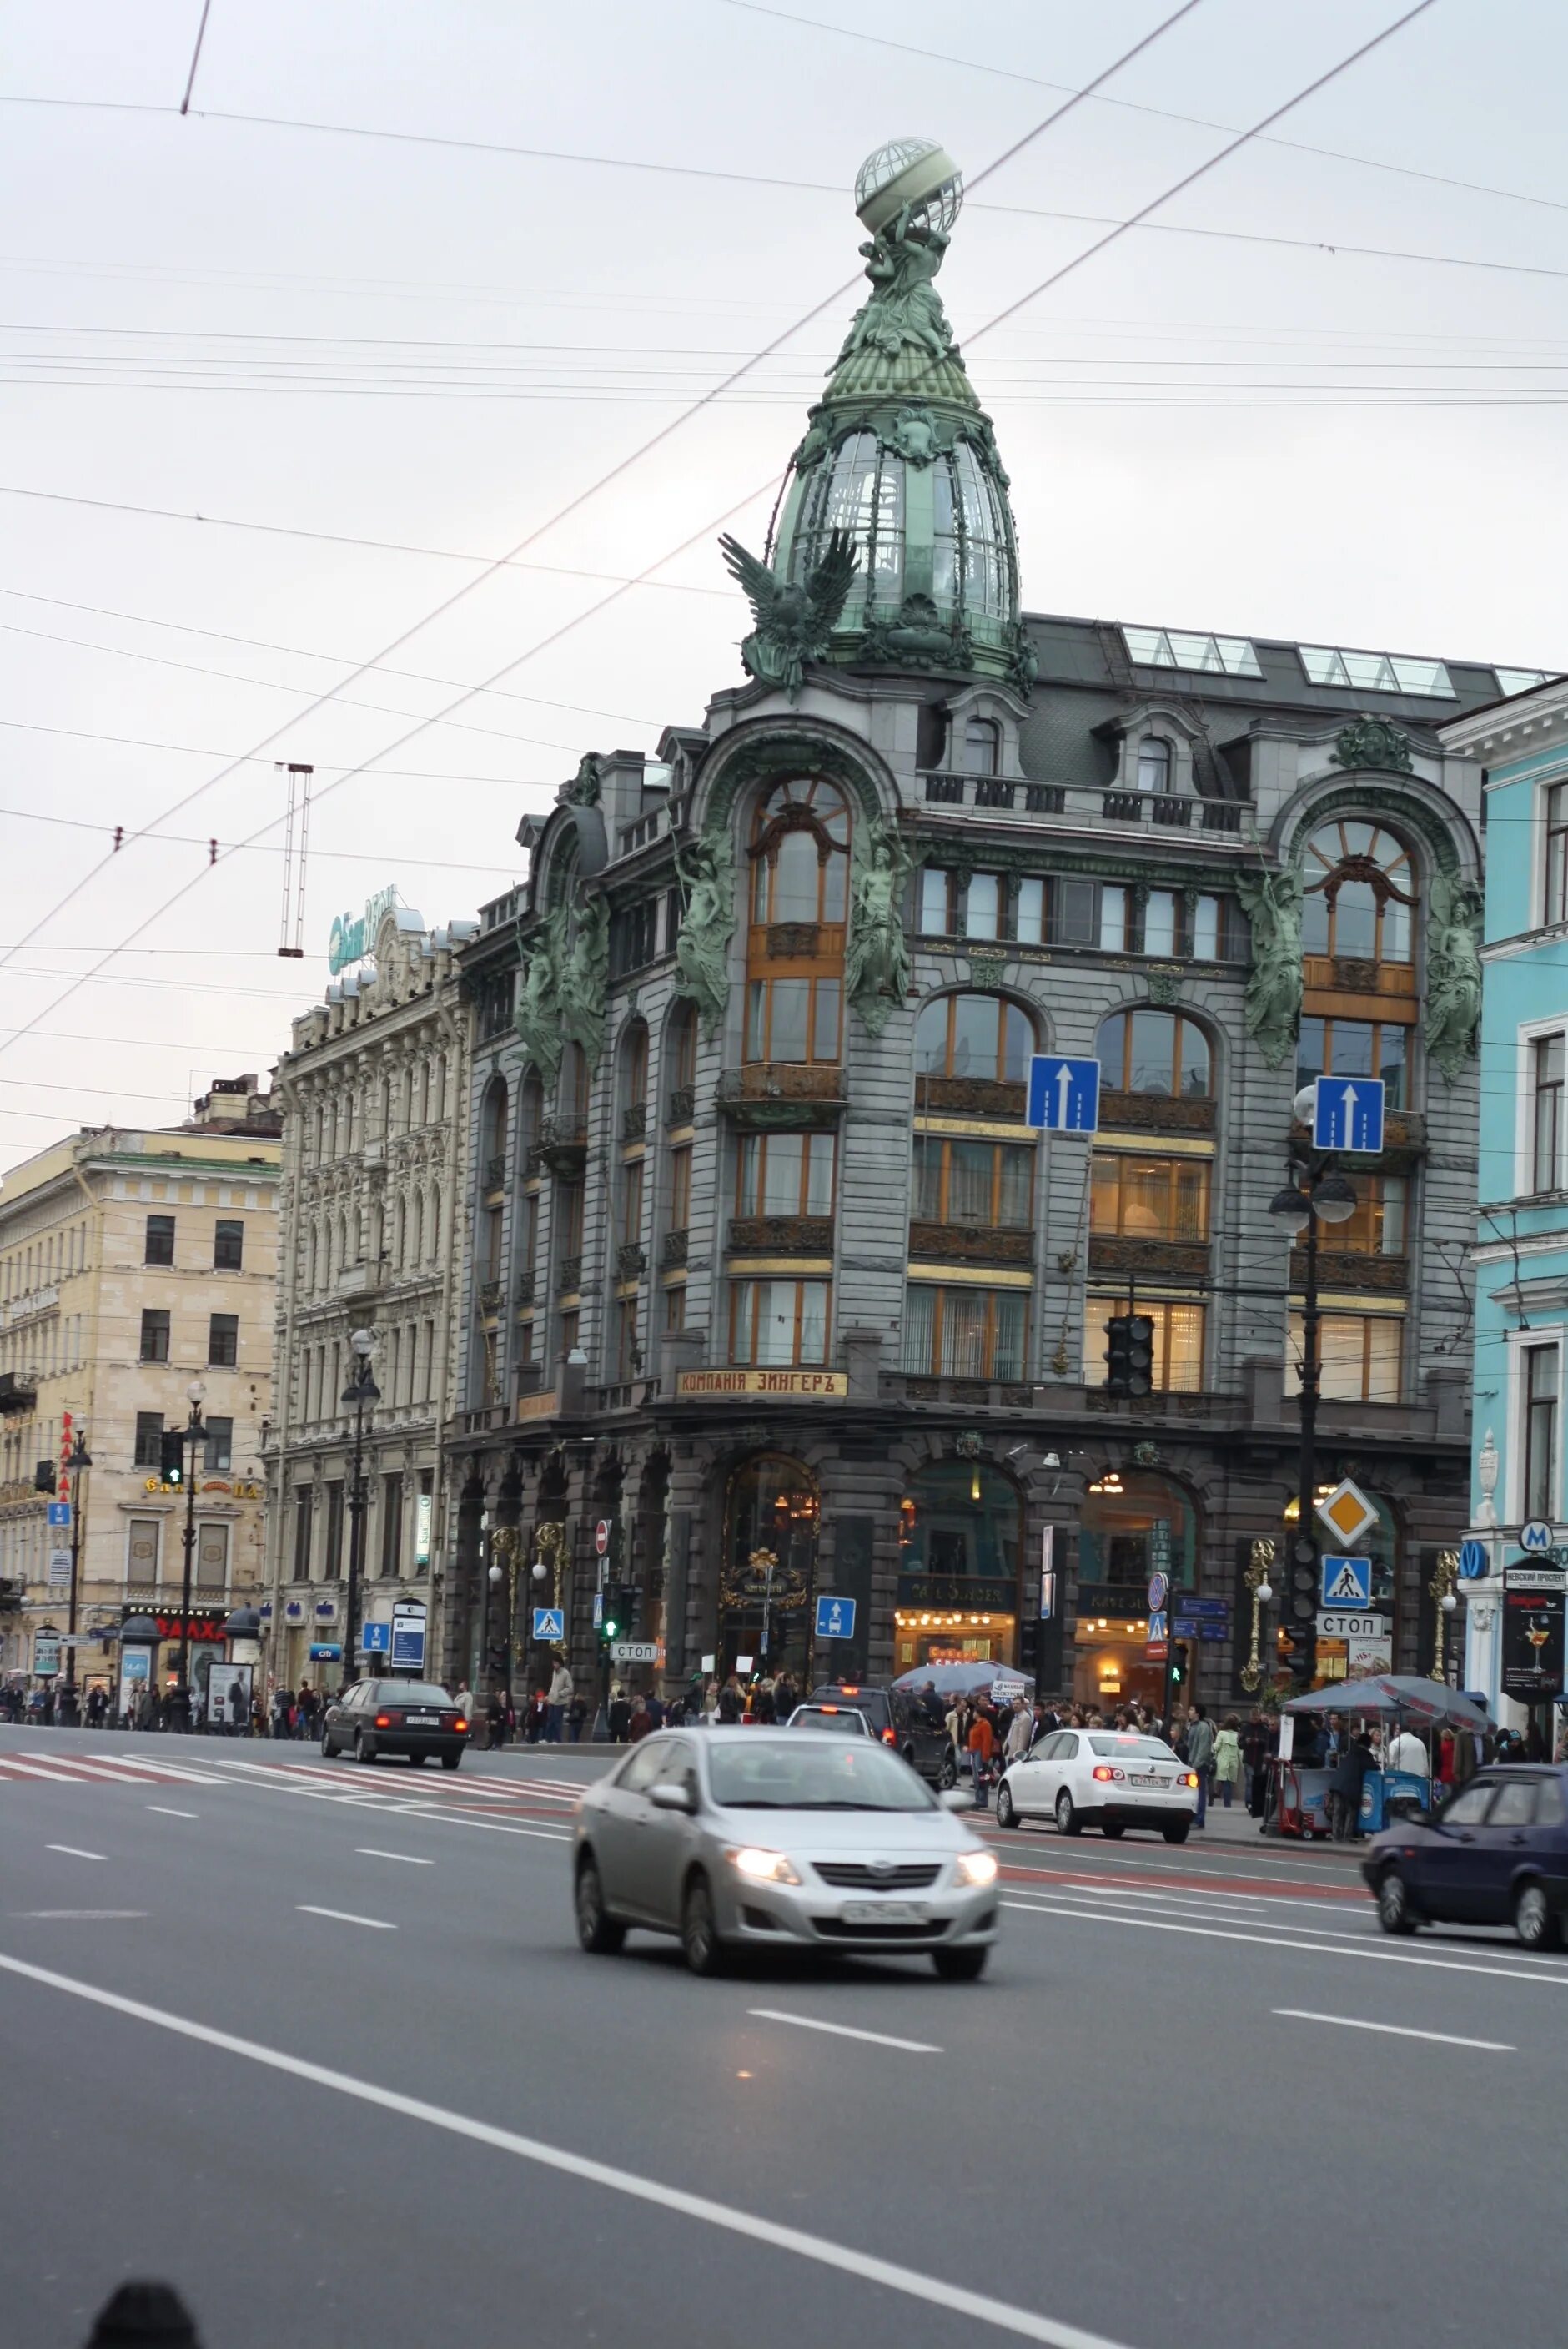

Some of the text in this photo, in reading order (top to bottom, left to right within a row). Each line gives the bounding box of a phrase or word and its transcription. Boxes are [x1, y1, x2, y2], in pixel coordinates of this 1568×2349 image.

[682, 1373, 834, 1392] КОМПАНІЯ ЗИНГЕРЪ
[1507, 1572, 1565, 1582] НЕВСКИЙ ПРОСПЕКТ
[1324, 1617, 1374, 1634] СТОП
[618, 1647, 652, 1657] СТОП
